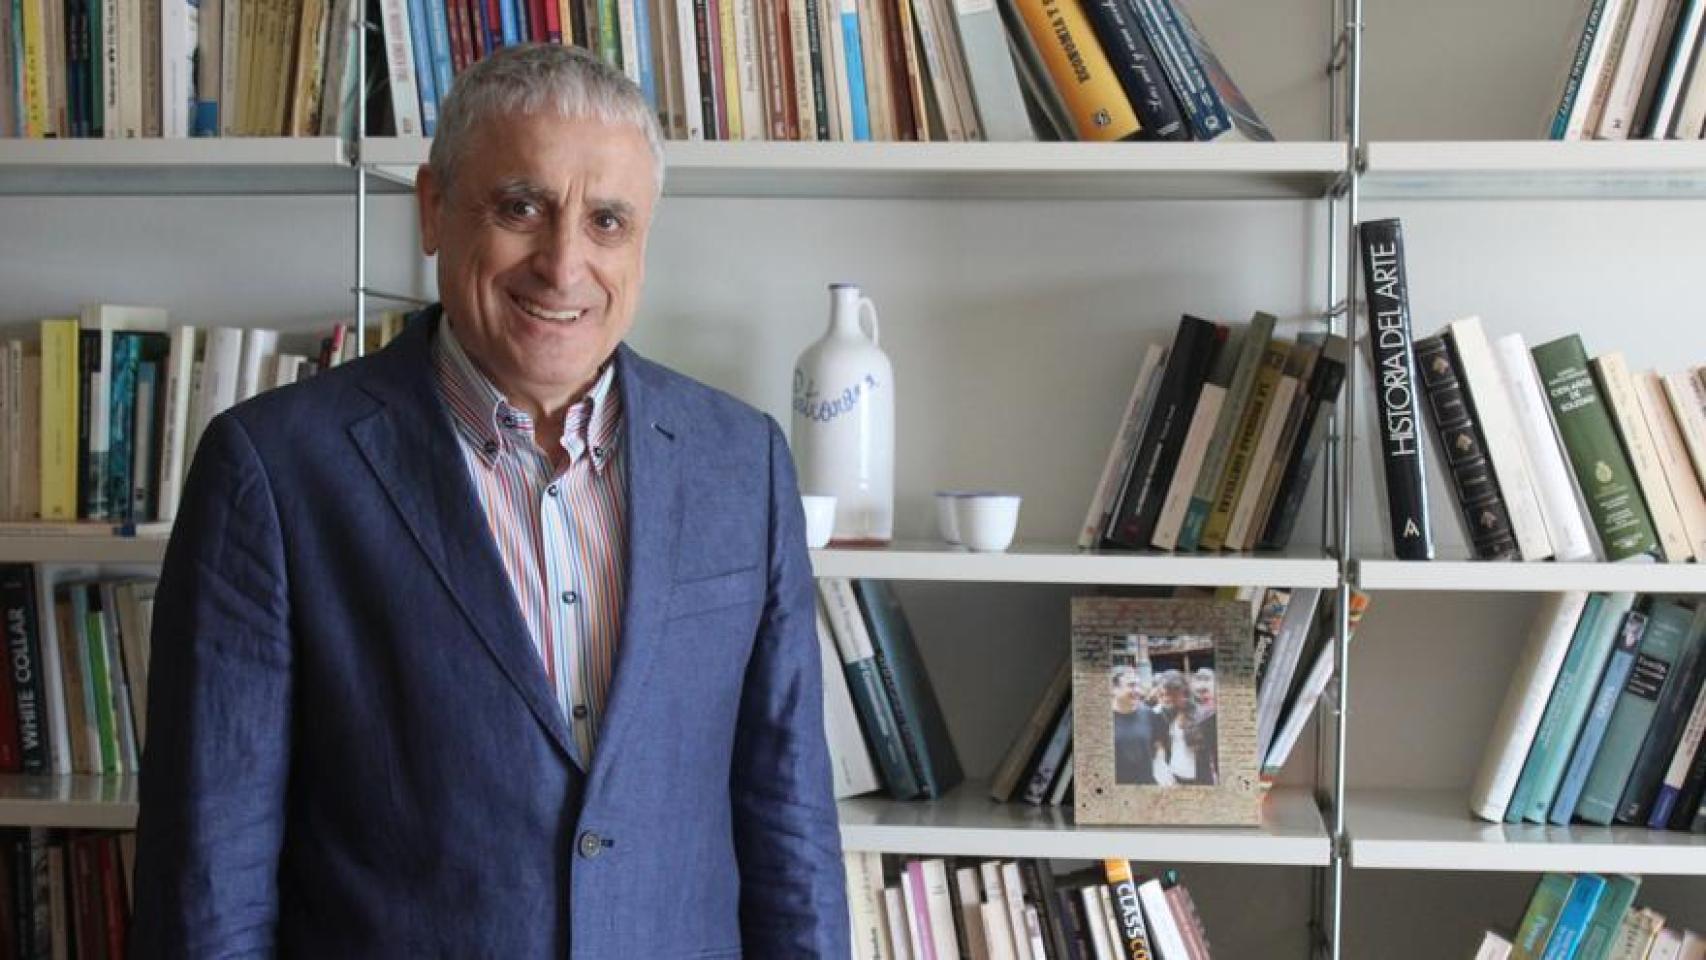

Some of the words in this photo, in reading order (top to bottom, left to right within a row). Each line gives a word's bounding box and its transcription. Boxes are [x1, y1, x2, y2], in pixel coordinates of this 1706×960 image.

[1371, 241, 1398, 299] ARTE
[1379, 305, 1405, 349] DEL
[1384, 351, 1416, 456] HISTORIA
[8, 608, 31, 683] COLLAR
[17, 685, 39, 750] WHITE
[1117, 883, 1146, 938] CLASS
